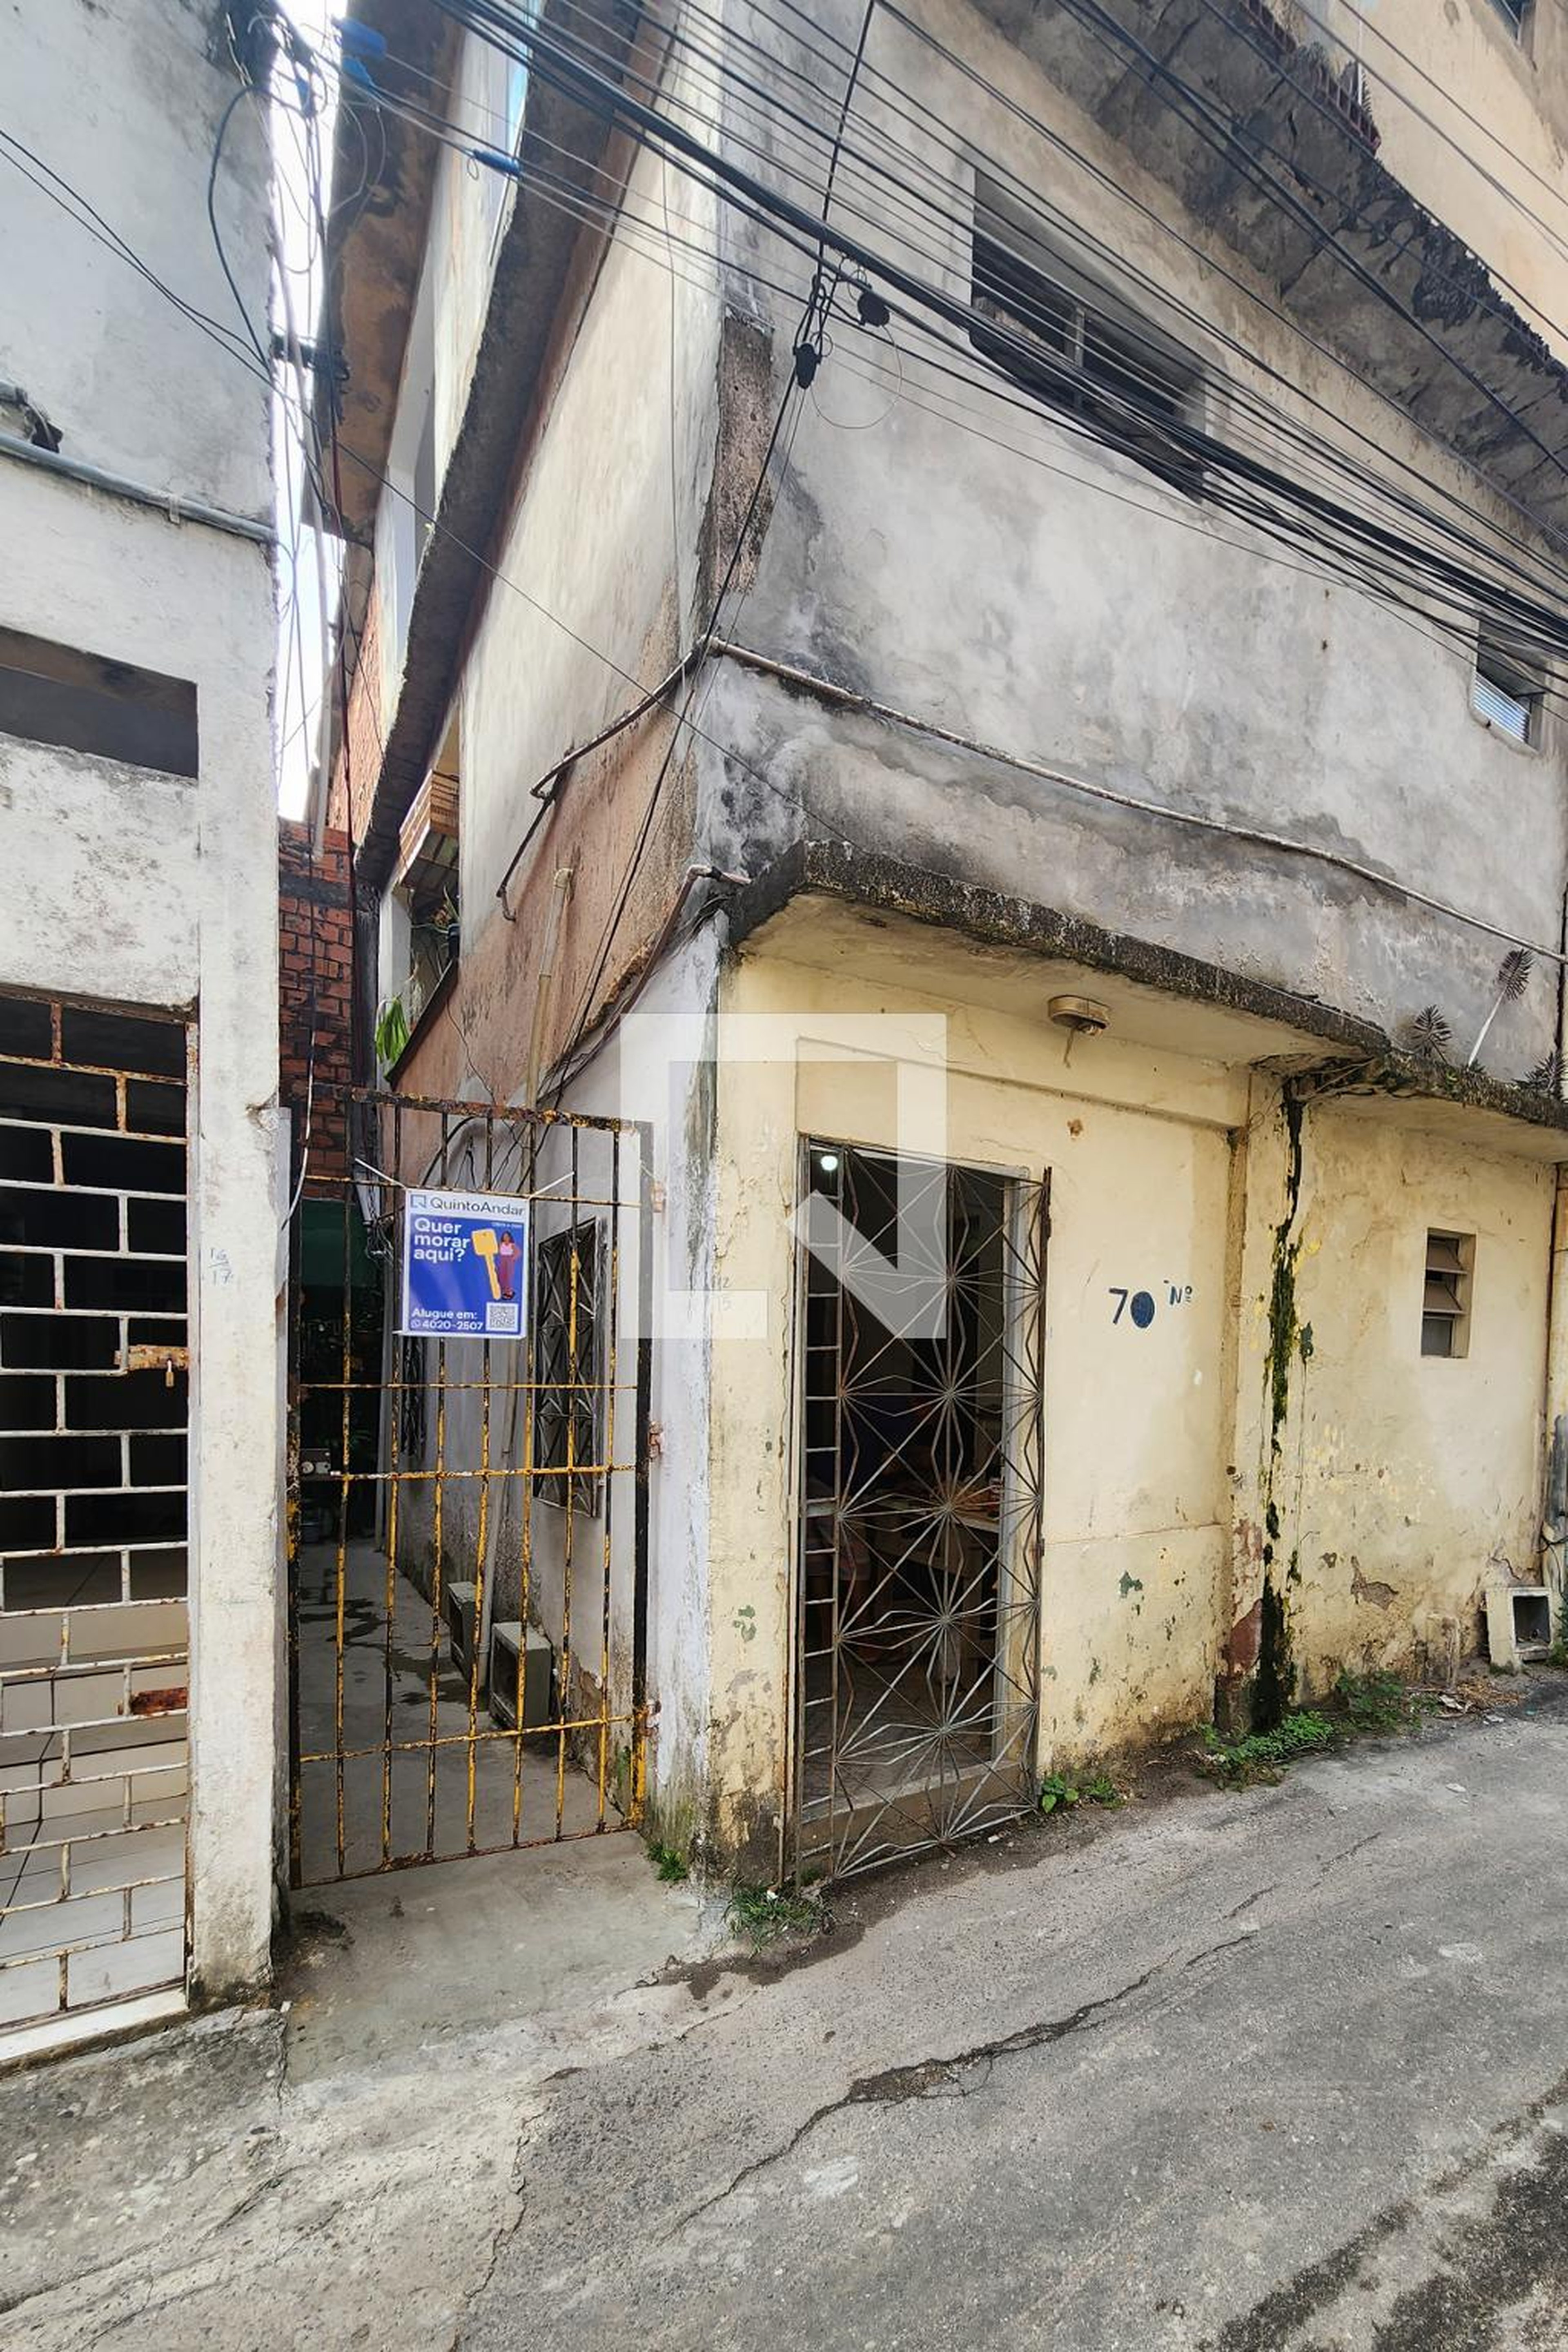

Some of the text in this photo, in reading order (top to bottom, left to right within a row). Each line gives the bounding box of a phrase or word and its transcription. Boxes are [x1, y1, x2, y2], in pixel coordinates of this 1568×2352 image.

[430, 1196, 525, 1216] QuintoAndar
[414, 1218, 462, 1234] Quer
[414, 1234, 470, 1248] morar
[413, 1247, 466, 1263] aqui?
[412, 1308, 477, 1320] Alugue em:
[422, 1321, 483, 1330] 4020-2507
